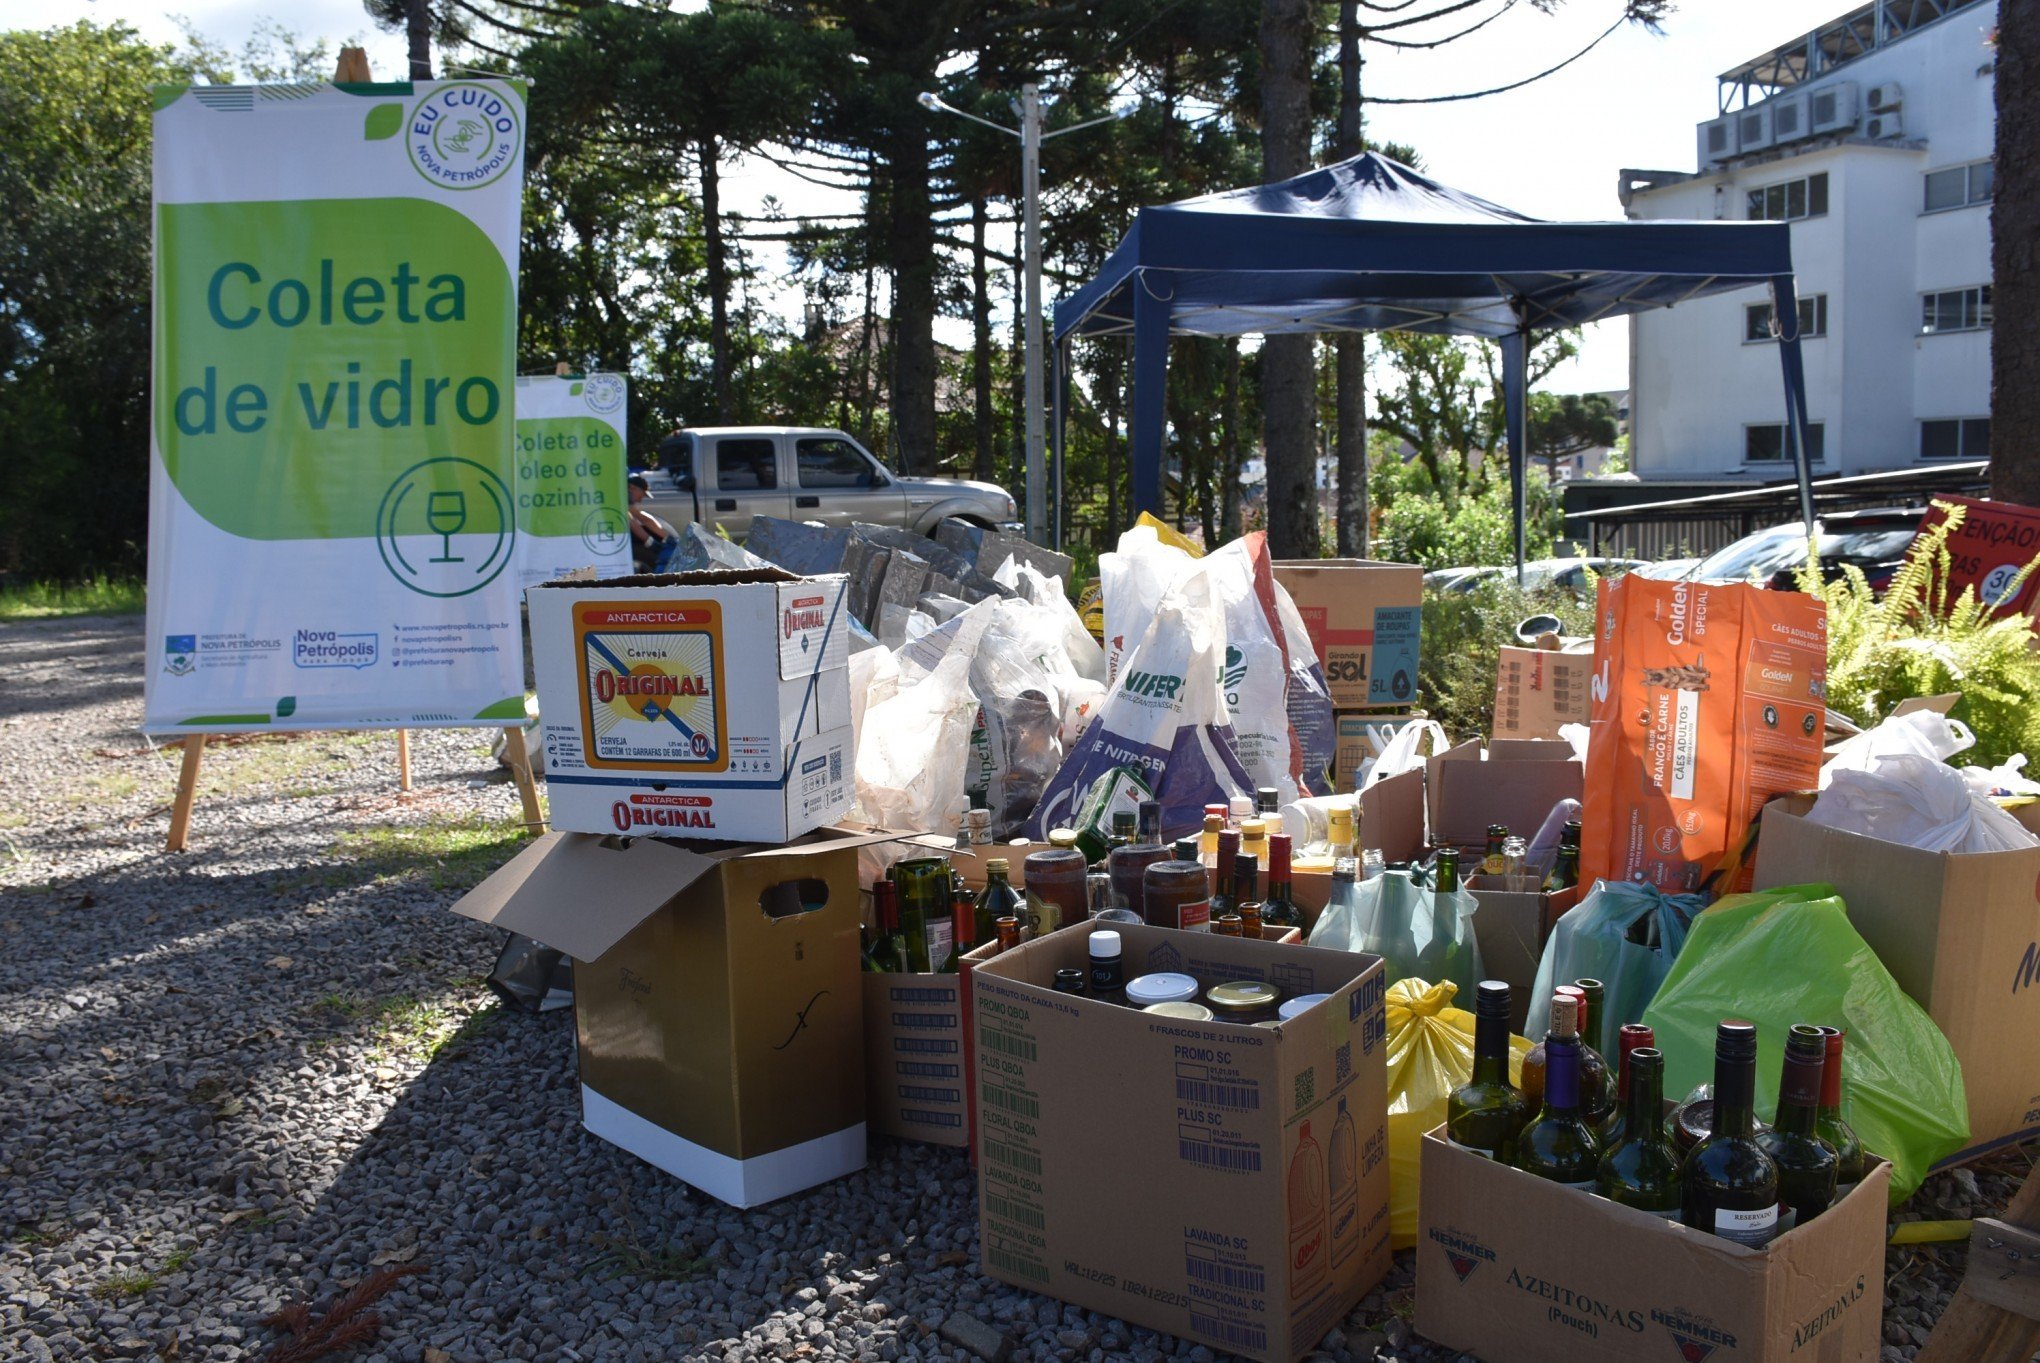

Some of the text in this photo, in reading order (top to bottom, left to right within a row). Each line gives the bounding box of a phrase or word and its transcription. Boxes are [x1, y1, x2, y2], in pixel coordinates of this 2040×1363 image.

[414, 89, 512, 135] EU CUIDO
[417, 143, 510, 181] NOVA PETRÓPOLIS
[207, 259, 466, 329] Coleta
[175, 360, 500, 435] de vidro
[586, 430, 614, 448] de
[520, 457, 602, 480] óleo de
[519, 487, 605, 508] cozinha
[607, 613, 686, 623] ANTARCTICA
[1696, 591, 1708, 635] SPECIAL
[201, 639, 281, 650] NOVA PETRÓPOLIS
[297, 630, 336, 642] Nova
[1791, 628, 1819, 641] ADULTOS
[297, 643, 374, 658] Petrópolis
[627, 648, 668, 659] Cerveja
[1327, 654, 1367, 681] sol
[1761, 668, 1792, 682] GoldeN
[1372, 680, 1388, 693] 5L
[1658, 694, 1669, 734] CARNE
[600, 736, 627, 746] CERVEJA
[601, 746, 623, 756] CONTÉM
[625, 748, 631, 756] 12
[632, 748, 661, 757] GARRAFAS
[662, 749, 670, 757] DE
[1674, 705, 1688, 780] CÃES ADULTOS
[1654, 743, 1666, 787] FRANGO
[642, 796, 701, 805] ANTARCTICA
[977, 981, 995, 993] PESO
[995, 986, 1019, 999] BRUTO
[1020, 993, 1030, 1002] DA
[1031, 996, 1054, 1009] CAIXA
[1070, 1006, 1079, 1017] kg
[978, 997, 1030, 1022] PROMO QBOA
[1156, 1025, 1200, 1039] FRASCOS
[1203, 1032, 1216, 1041] DE
[1219, 1034, 1225, 1042] 2
[1226, 1035, 1263, 1046] LITROS
[981, 1054, 1024, 1077] PLUS QBOA
[1174, 1045, 1232, 1065] PROMO SC
[983, 1109, 1037, 1138] FLORAL QBOA
[1177, 1107, 1205, 1123] PLUS
[1207, 1112, 1222, 1126] SC
[984, 1164, 1043, 1195] LAVANDA QBOA
[1734, 1211, 1772, 1221] RESERVADO
[987, 1218, 1046, 1250] TRADICIONAL QBOA
[1184, 1226, 1248, 1251] LAVANDA SC
[1428, 1227, 1496, 1264] HEMMER
[1187, 1282, 1265, 1313] TRADICIONAL SC
[1506, 1266, 1645, 1334] AZEITONAS
[1547, 1307, 1599, 1340] (Pouch)
[1790, 1273, 1865, 1354] AZEITONAS
[1650, 1308, 1737, 1350] HEMMER
